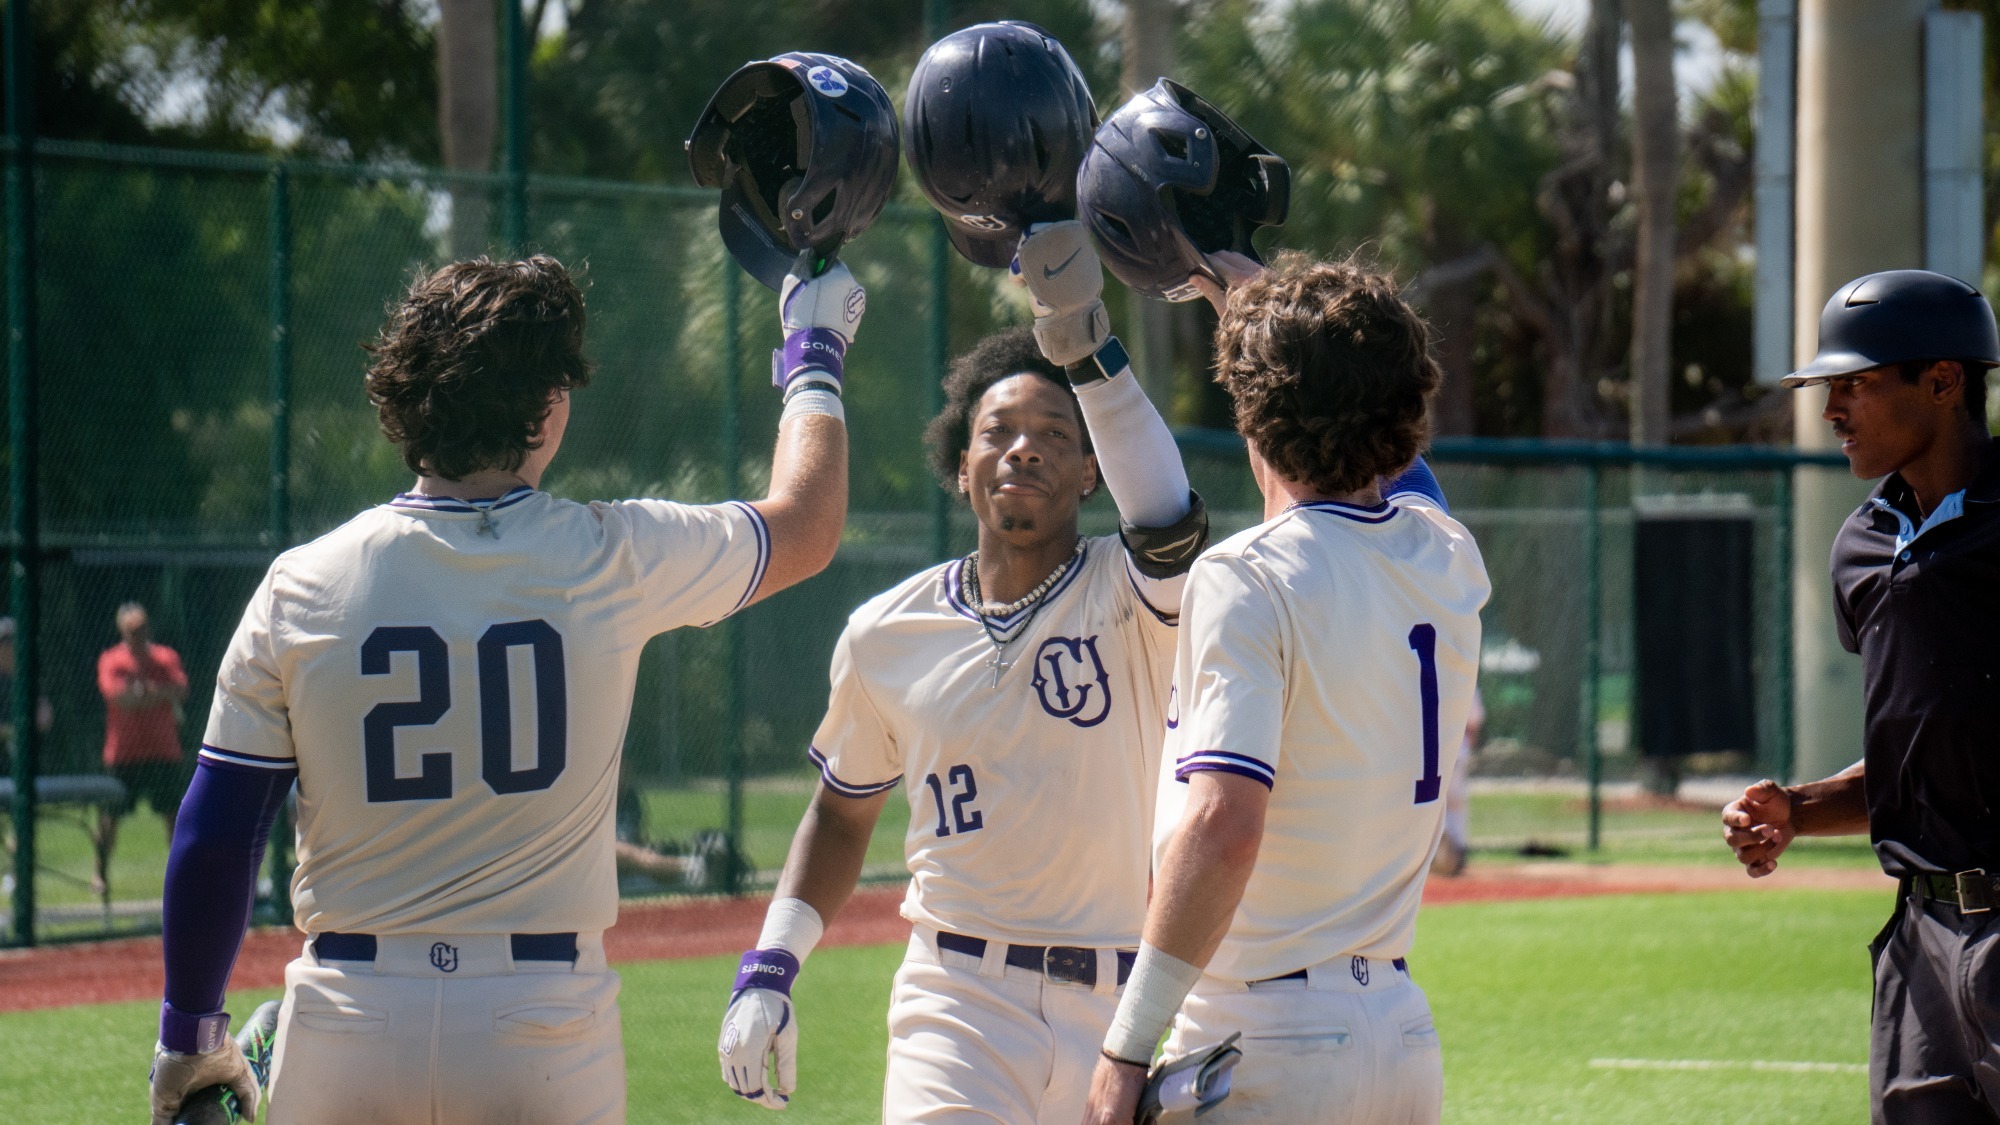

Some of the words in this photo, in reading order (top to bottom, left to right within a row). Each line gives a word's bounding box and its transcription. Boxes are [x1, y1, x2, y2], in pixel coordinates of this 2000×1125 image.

[361, 619, 567, 802] 20
[1408, 623, 1441, 804] 1
[926, 764, 982, 837] 12
[742, 963, 785, 976] COMETS
